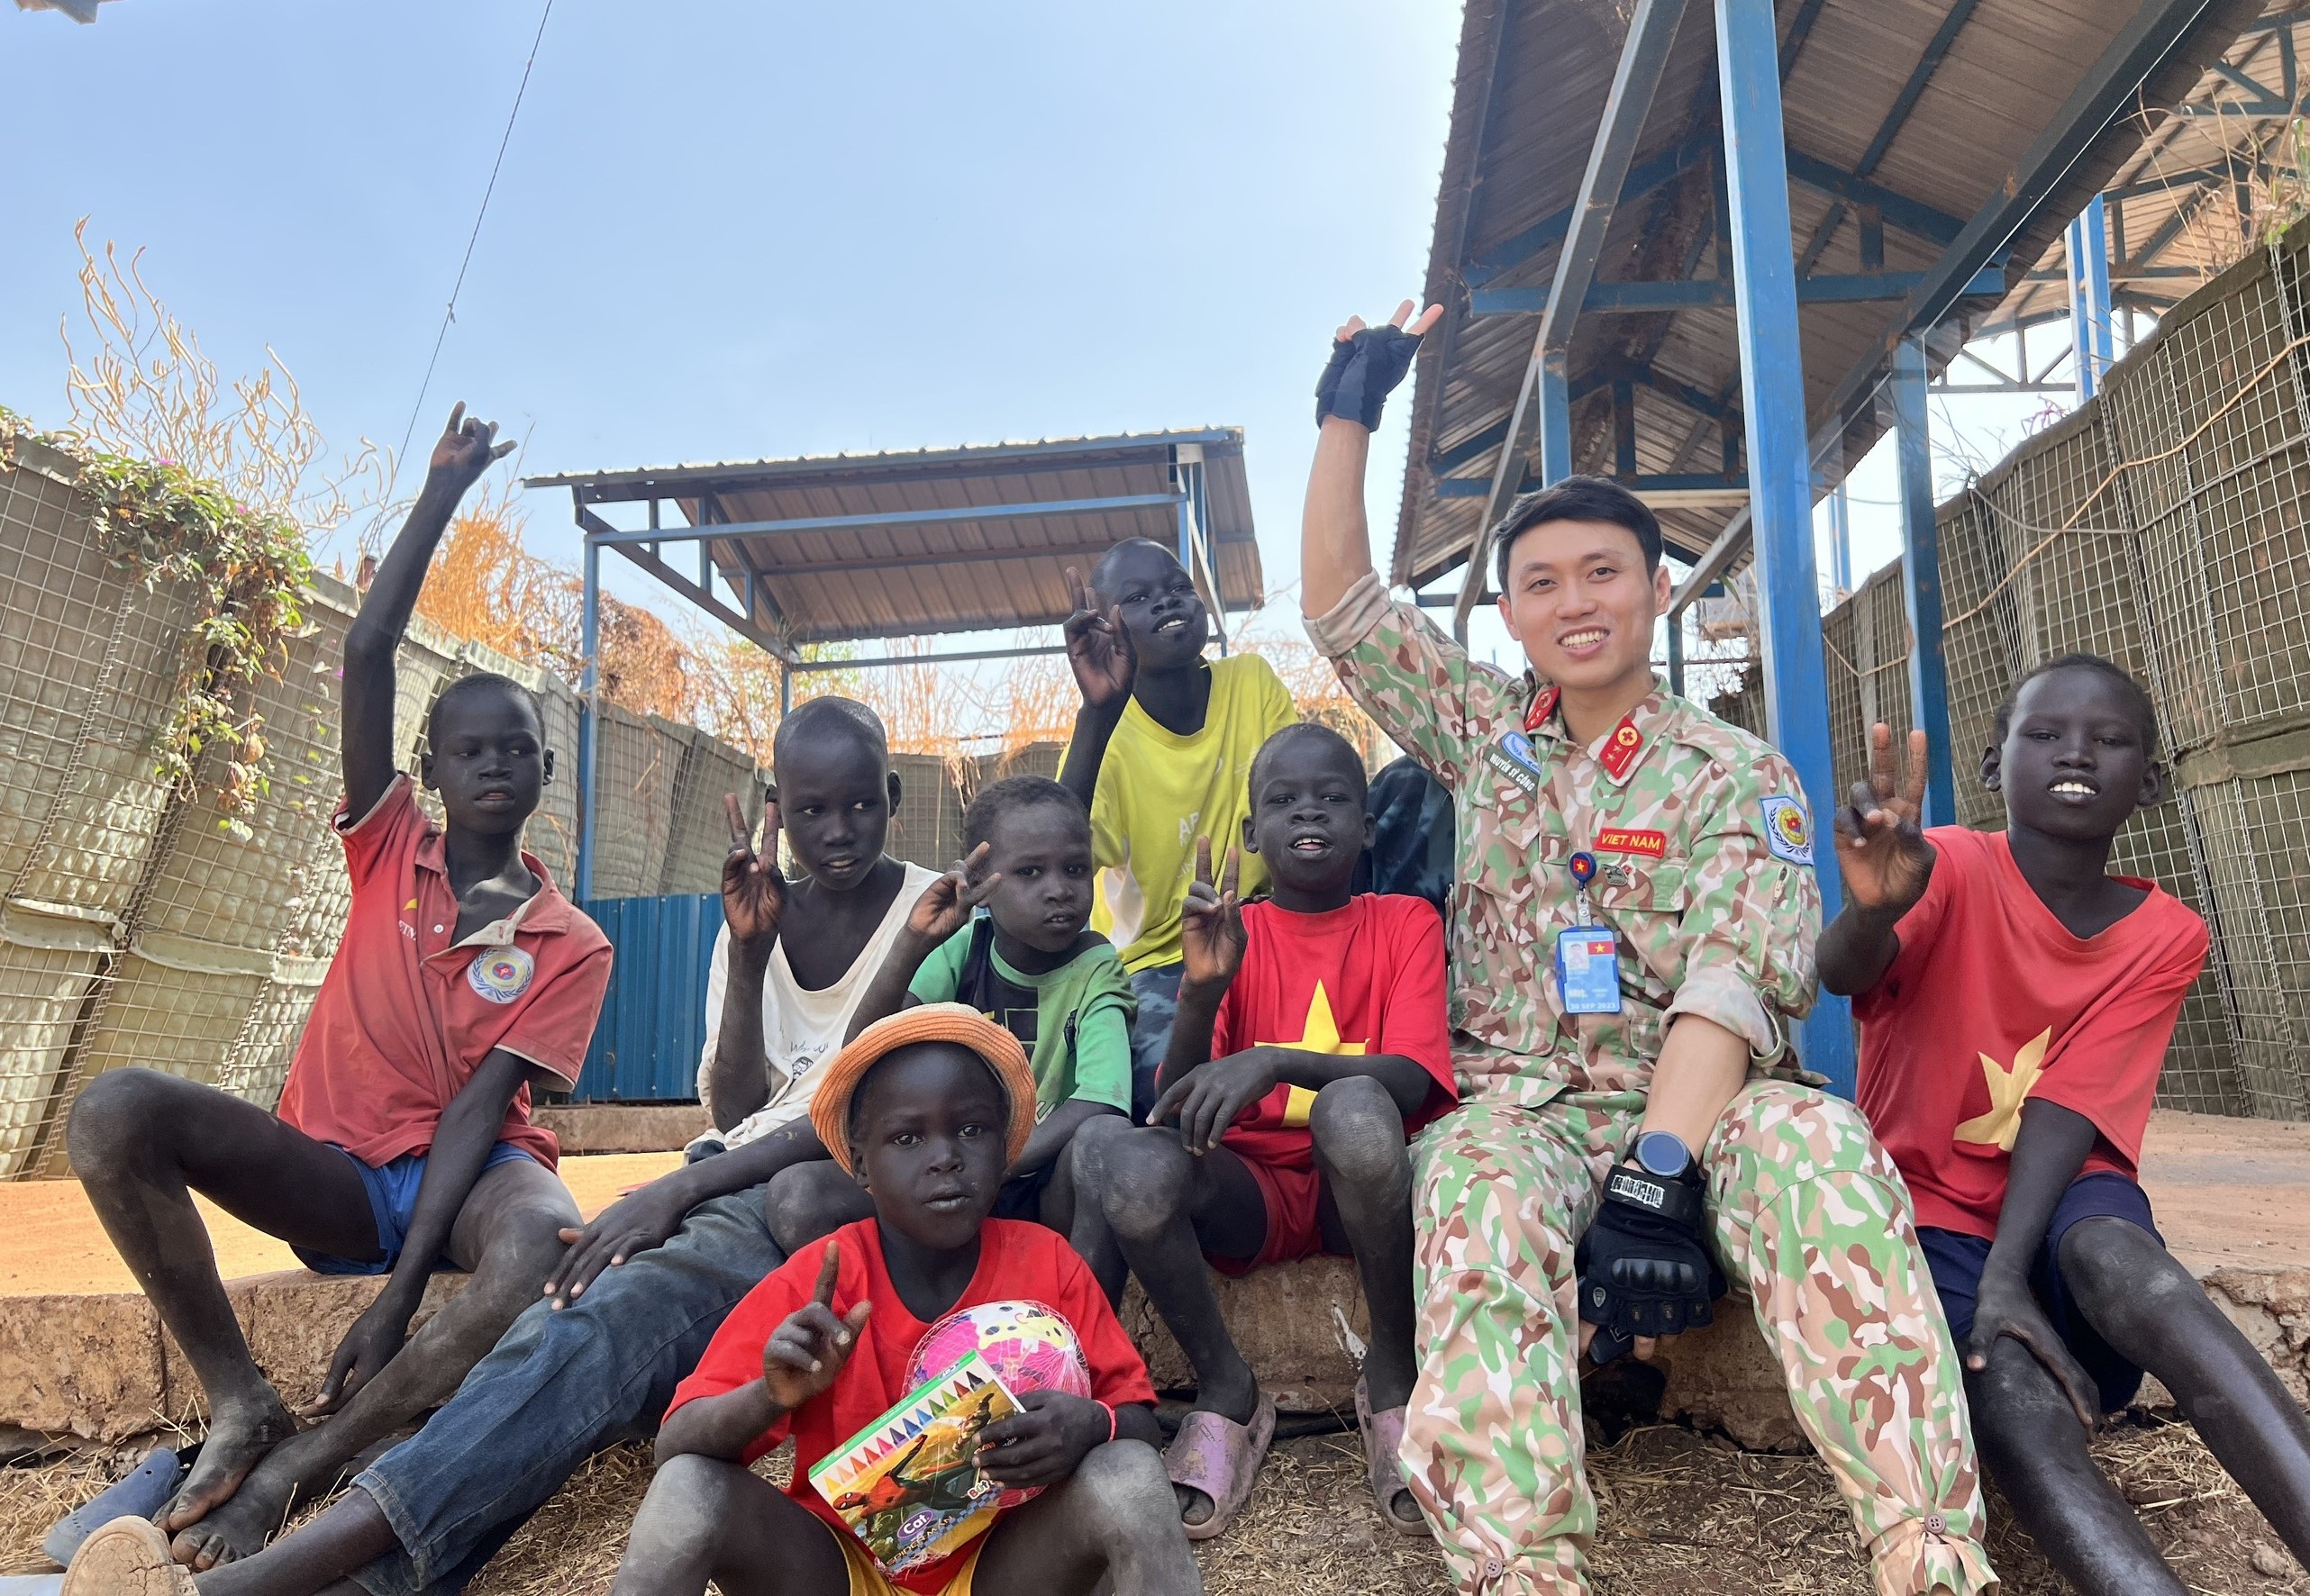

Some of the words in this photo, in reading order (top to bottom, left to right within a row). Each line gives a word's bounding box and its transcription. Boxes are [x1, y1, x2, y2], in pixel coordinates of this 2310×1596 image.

[1601, 833, 1628, 846] VIET
[1629, 835, 1661, 850] NAM
[903, 1514, 928, 1534] Cat
